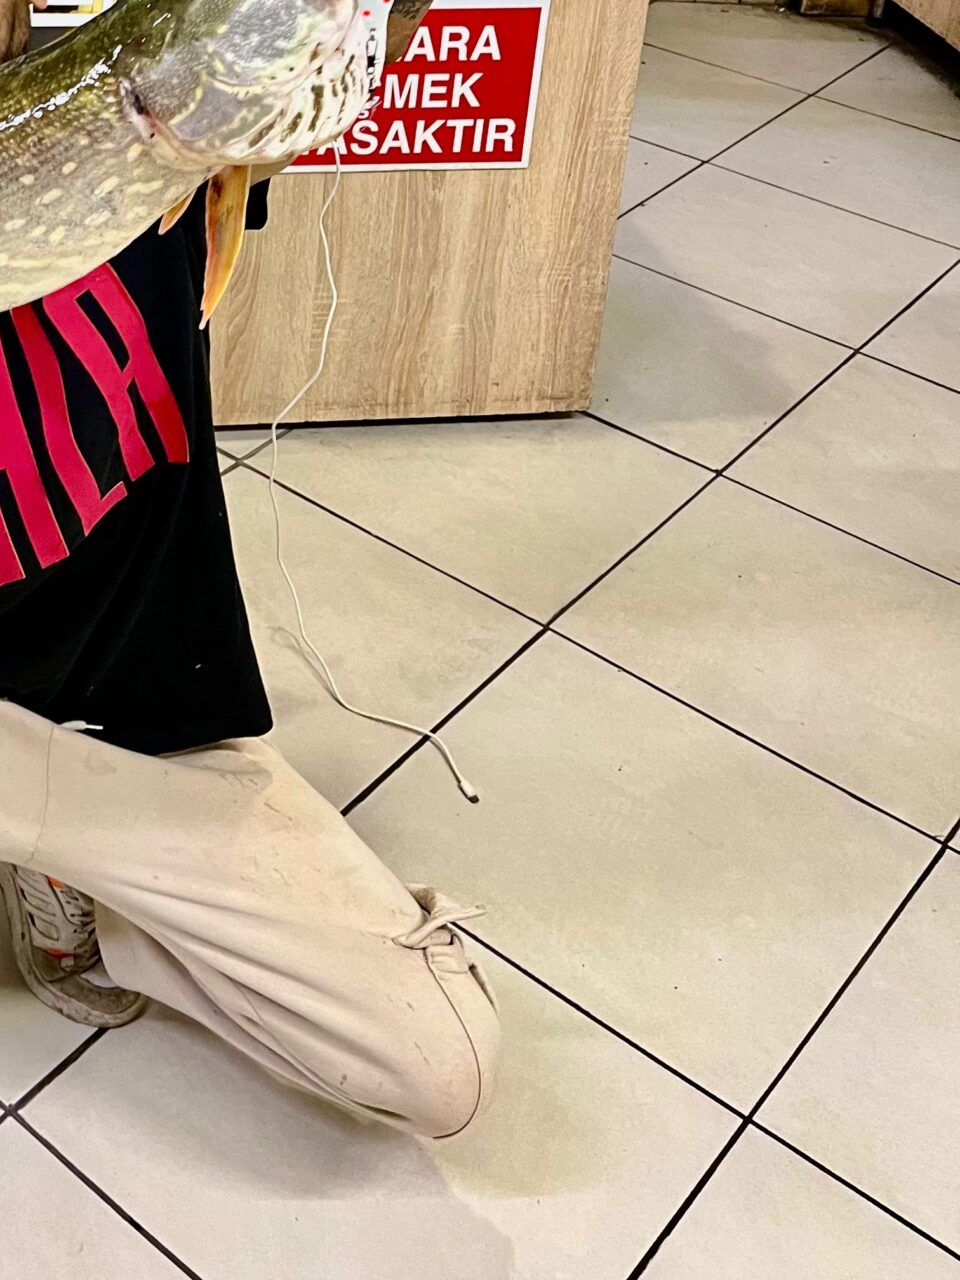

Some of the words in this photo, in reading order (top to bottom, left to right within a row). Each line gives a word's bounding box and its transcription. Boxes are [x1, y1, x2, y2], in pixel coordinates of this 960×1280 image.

[398, 25, 501, 62] ARA
[381, 72, 484, 109] MEK
[304, 118, 517, 156] ASAKTIR
